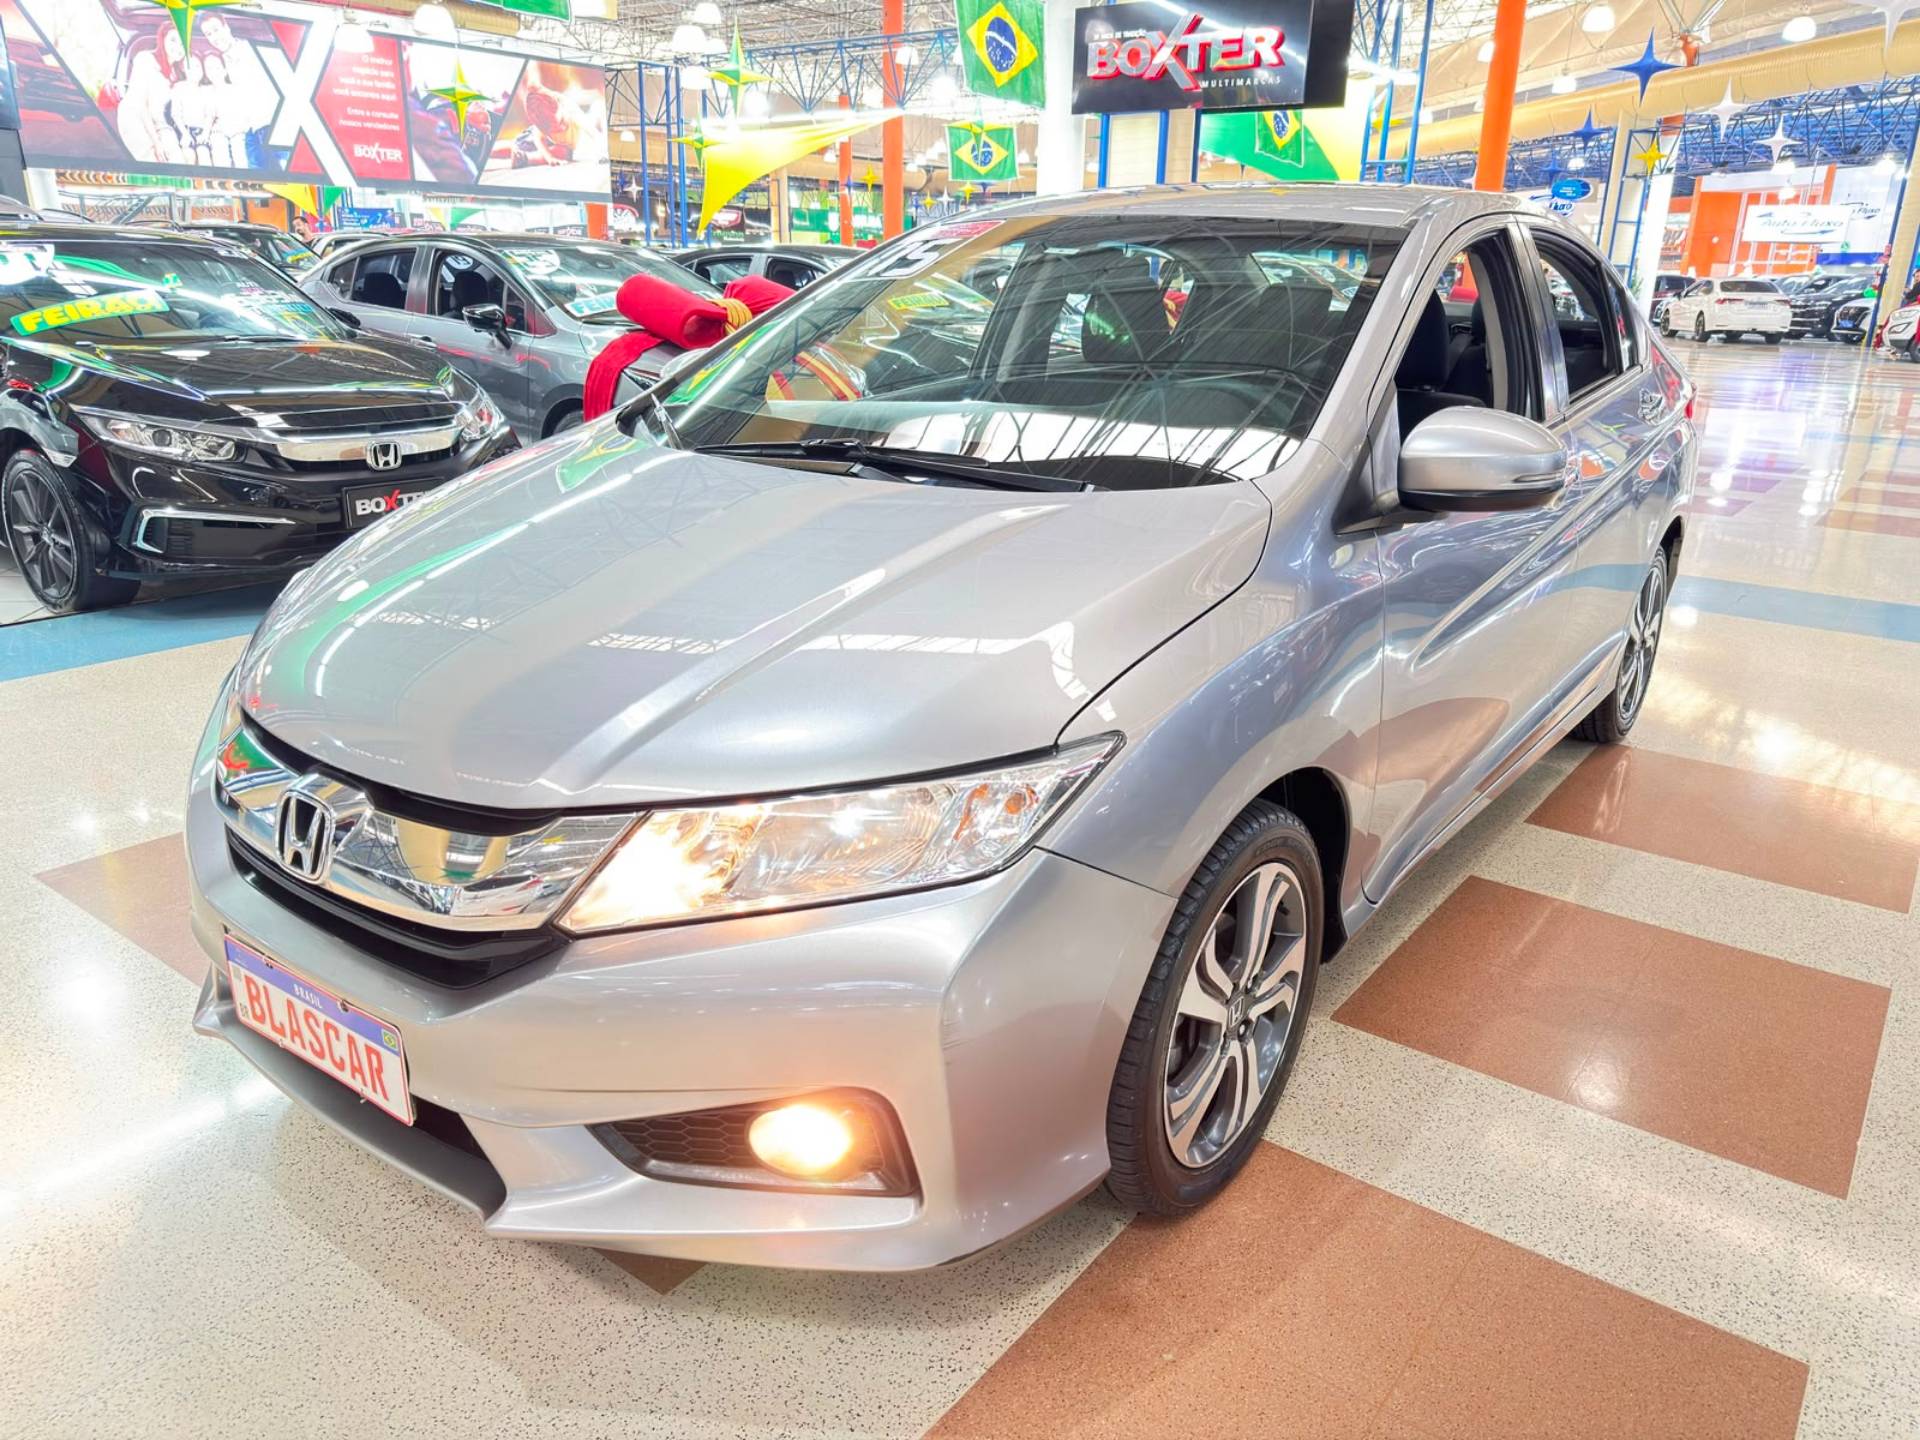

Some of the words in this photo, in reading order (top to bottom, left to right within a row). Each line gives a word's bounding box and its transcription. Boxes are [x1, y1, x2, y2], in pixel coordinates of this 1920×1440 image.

[1087, 14, 1286, 91] BOXTER
[1200, 76, 1281, 89] MULTIMARCAS
[353, 143, 403, 164] BOXTER
[293, 983, 322, 1009] BRASIL
[244, 975, 388, 1101] BLASCAR
